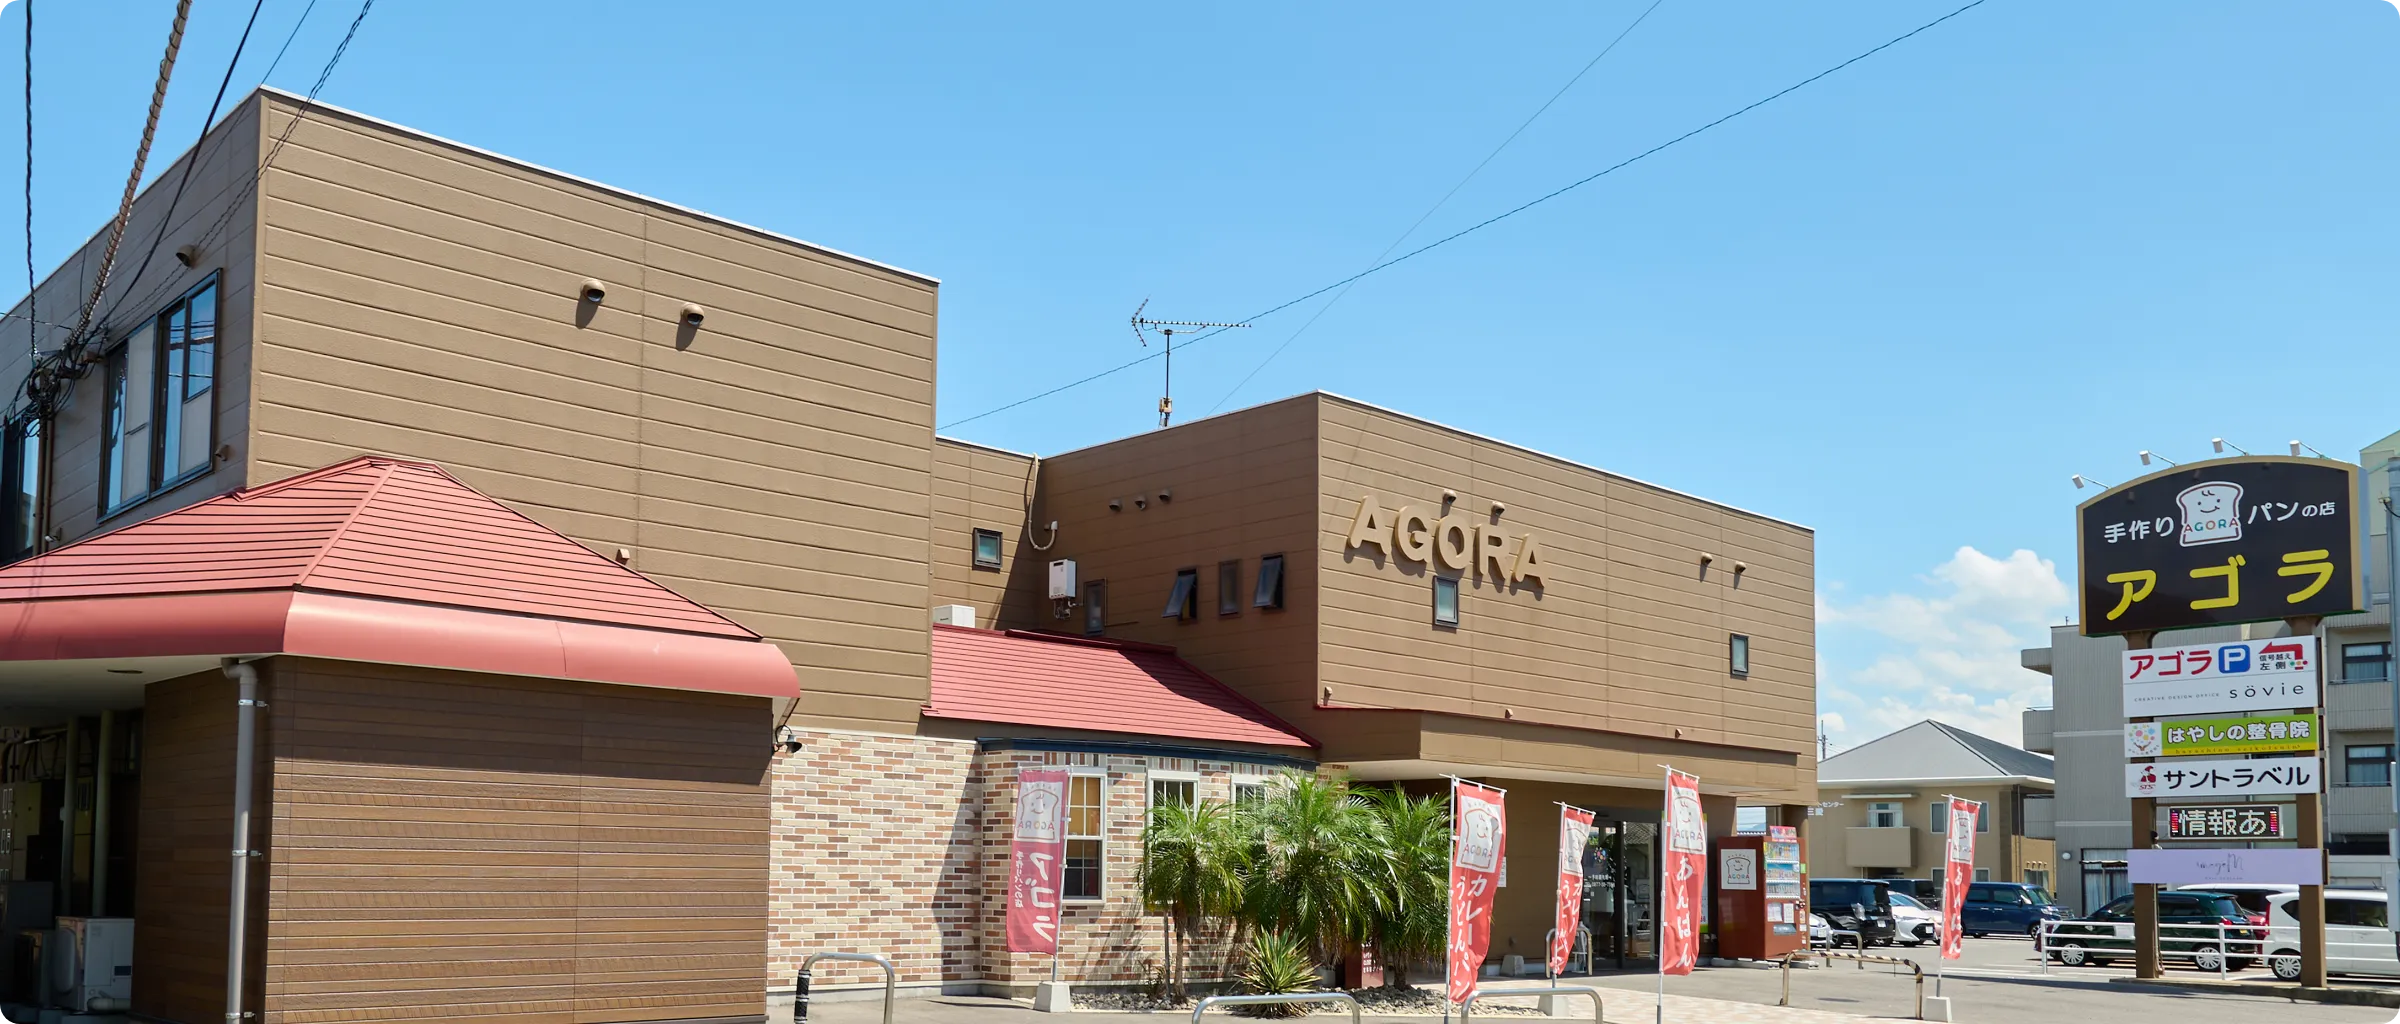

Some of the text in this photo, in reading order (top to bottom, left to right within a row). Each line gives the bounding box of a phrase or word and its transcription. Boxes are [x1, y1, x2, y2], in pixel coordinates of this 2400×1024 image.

[2104, 501, 2336, 543] 手作り パンの店
[2183, 517, 2239, 533] AGORA
[1348, 495, 1545, 588] AGORA
[2106, 549, 2335, 620] アゴラ
[2129, 650, 2213, 680] アゴラ
[2229, 682, 2304, 699] sövie
[2167, 720, 2311, 744] はやしの整骨院
[2163, 766, 2311, 790] サントラベル
[2178, 809, 2267, 836] 情報あ
